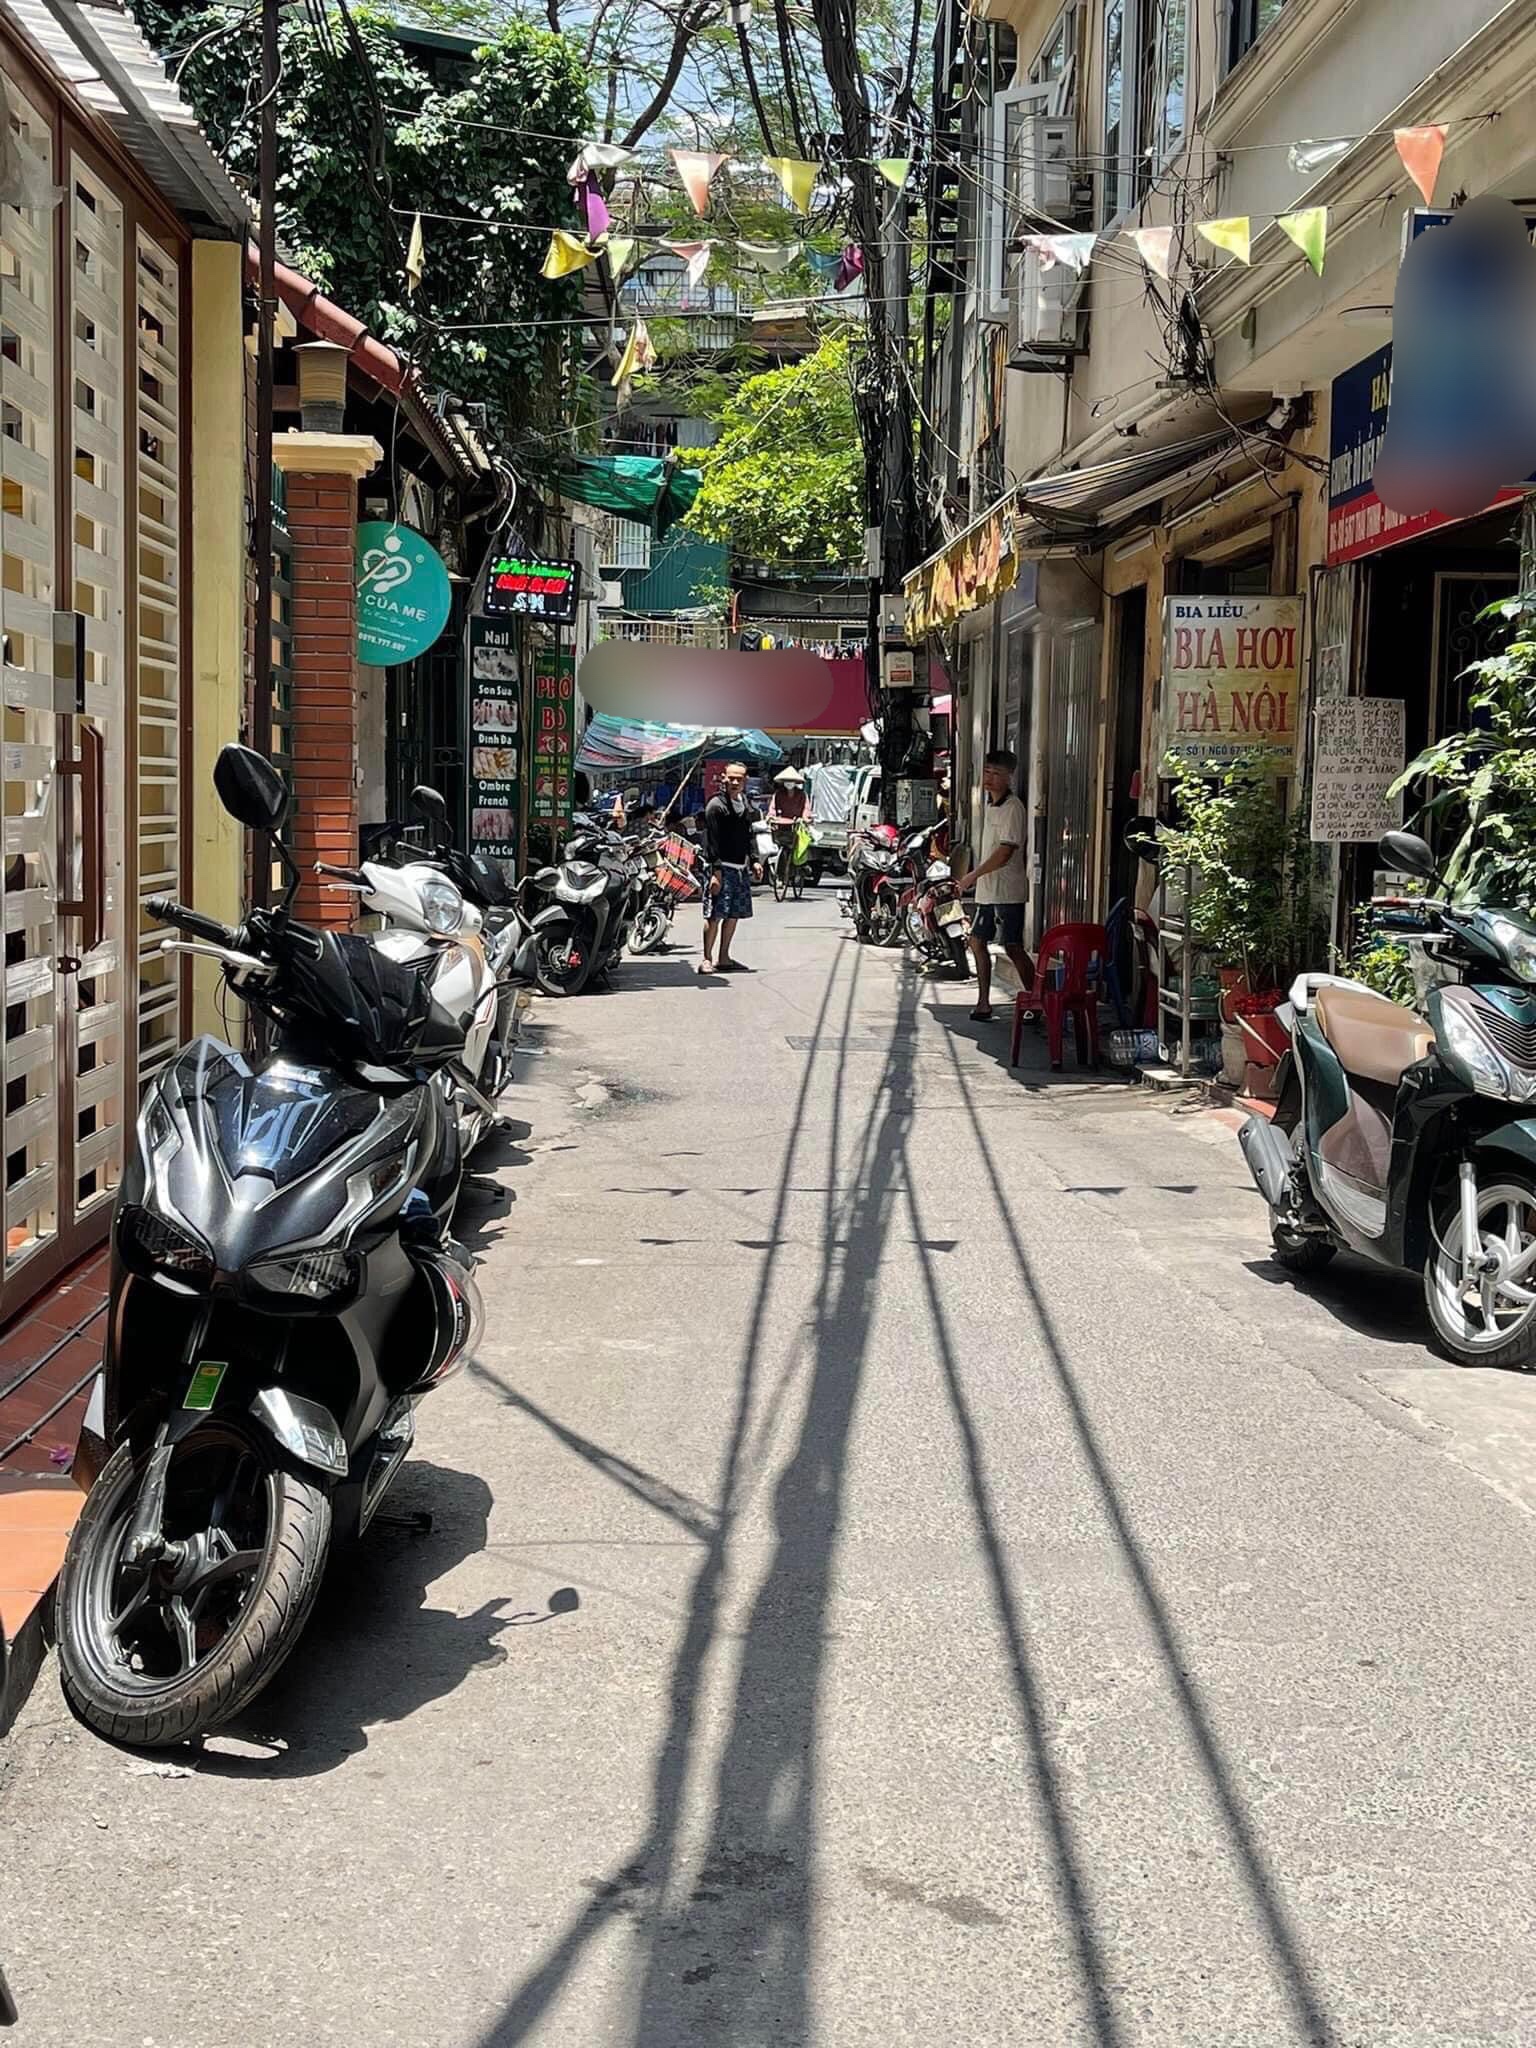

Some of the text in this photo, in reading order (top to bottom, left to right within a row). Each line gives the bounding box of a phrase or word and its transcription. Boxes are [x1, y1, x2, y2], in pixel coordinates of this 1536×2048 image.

[1175, 606, 1202, 618] BIA
[484, 630, 509, 646] Nail
[1173, 627, 1296, 669] BIA HƠI
[536, 668, 574, 700] PHỞ
[1176, 680, 1289, 739] HÀ NỘI
[478, 781, 511, 792] Ombre
[478, 795, 509, 806] French
